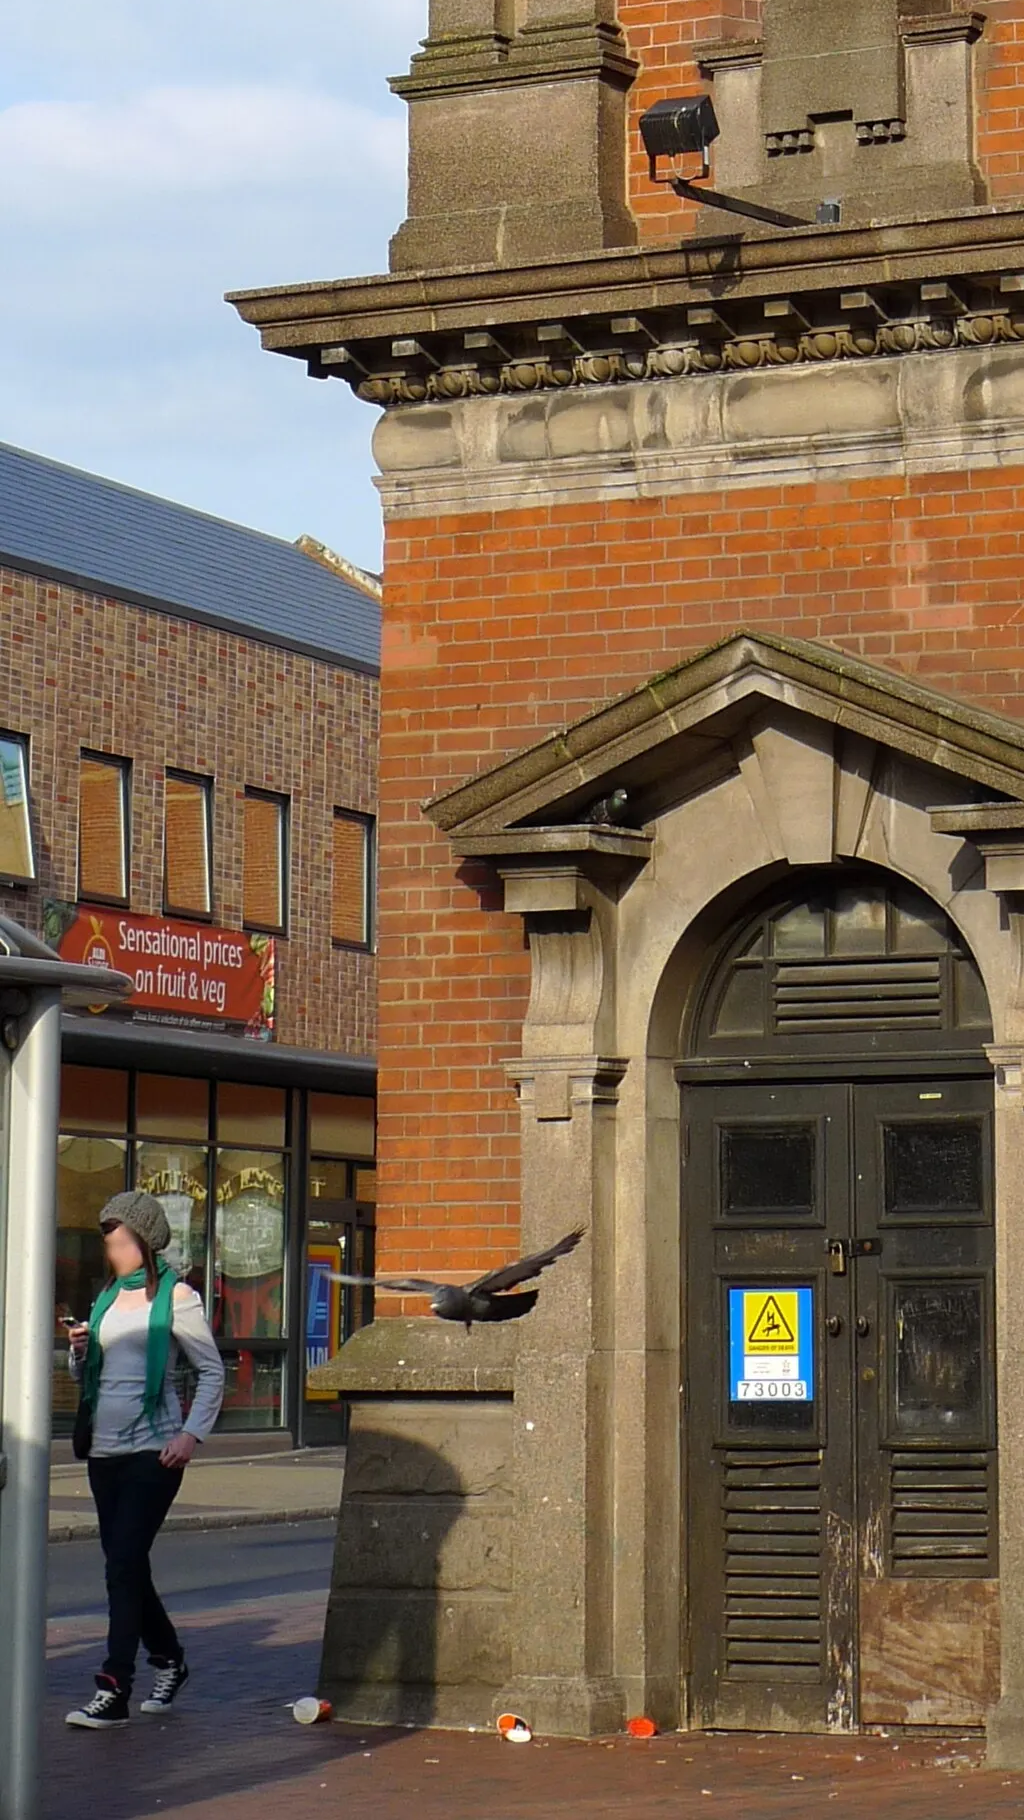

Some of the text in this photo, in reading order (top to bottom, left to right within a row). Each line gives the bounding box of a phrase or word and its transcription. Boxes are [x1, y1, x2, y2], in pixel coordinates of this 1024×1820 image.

[118, 921, 243, 971] Sensational prices
[135, 965, 226, 1012] on fruit & veg
[741, 1382, 804, 1397] 73003
